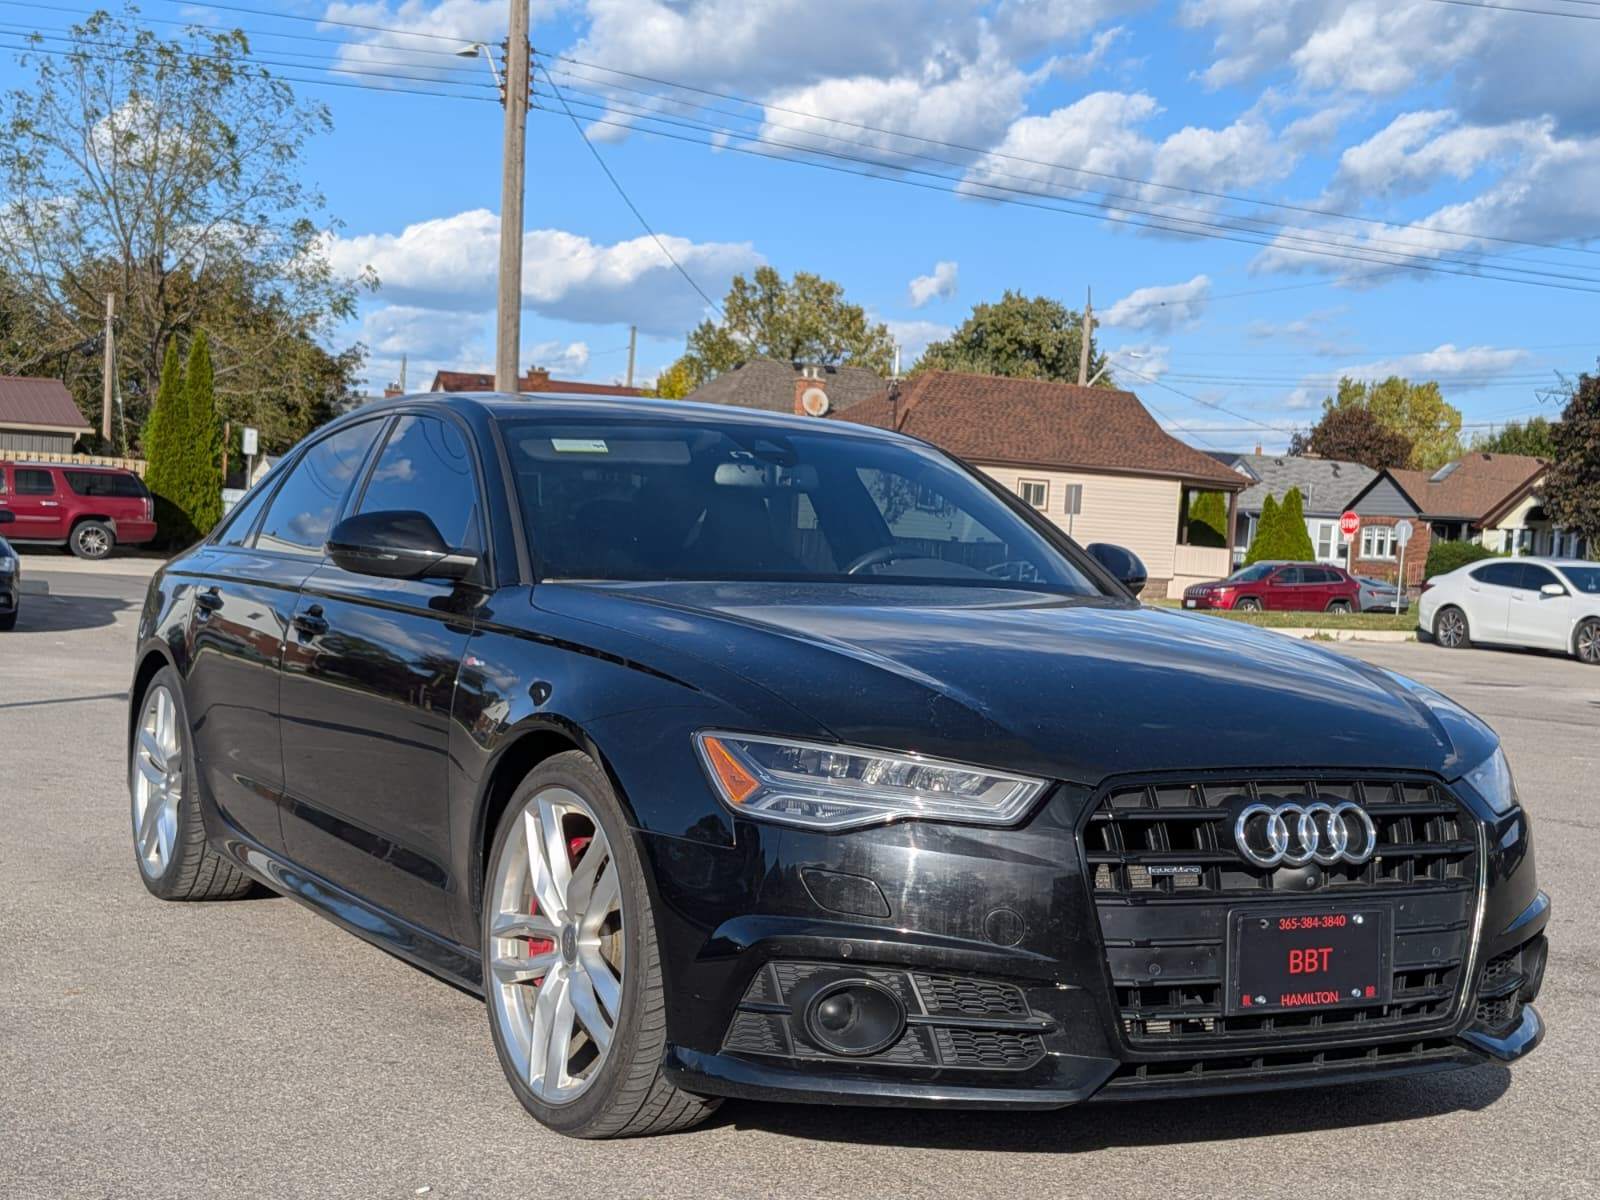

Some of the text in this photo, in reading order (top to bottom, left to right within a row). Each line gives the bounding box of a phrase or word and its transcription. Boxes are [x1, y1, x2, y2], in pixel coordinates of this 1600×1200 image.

[1341, 518, 1359, 528] STOP
[1150, 866, 1200, 875] quattro
[1279, 914, 1346, 930] 365-384-3840
[1289, 947, 1334, 974] BBT
[1281, 992, 1339, 1006] HAMILTON
